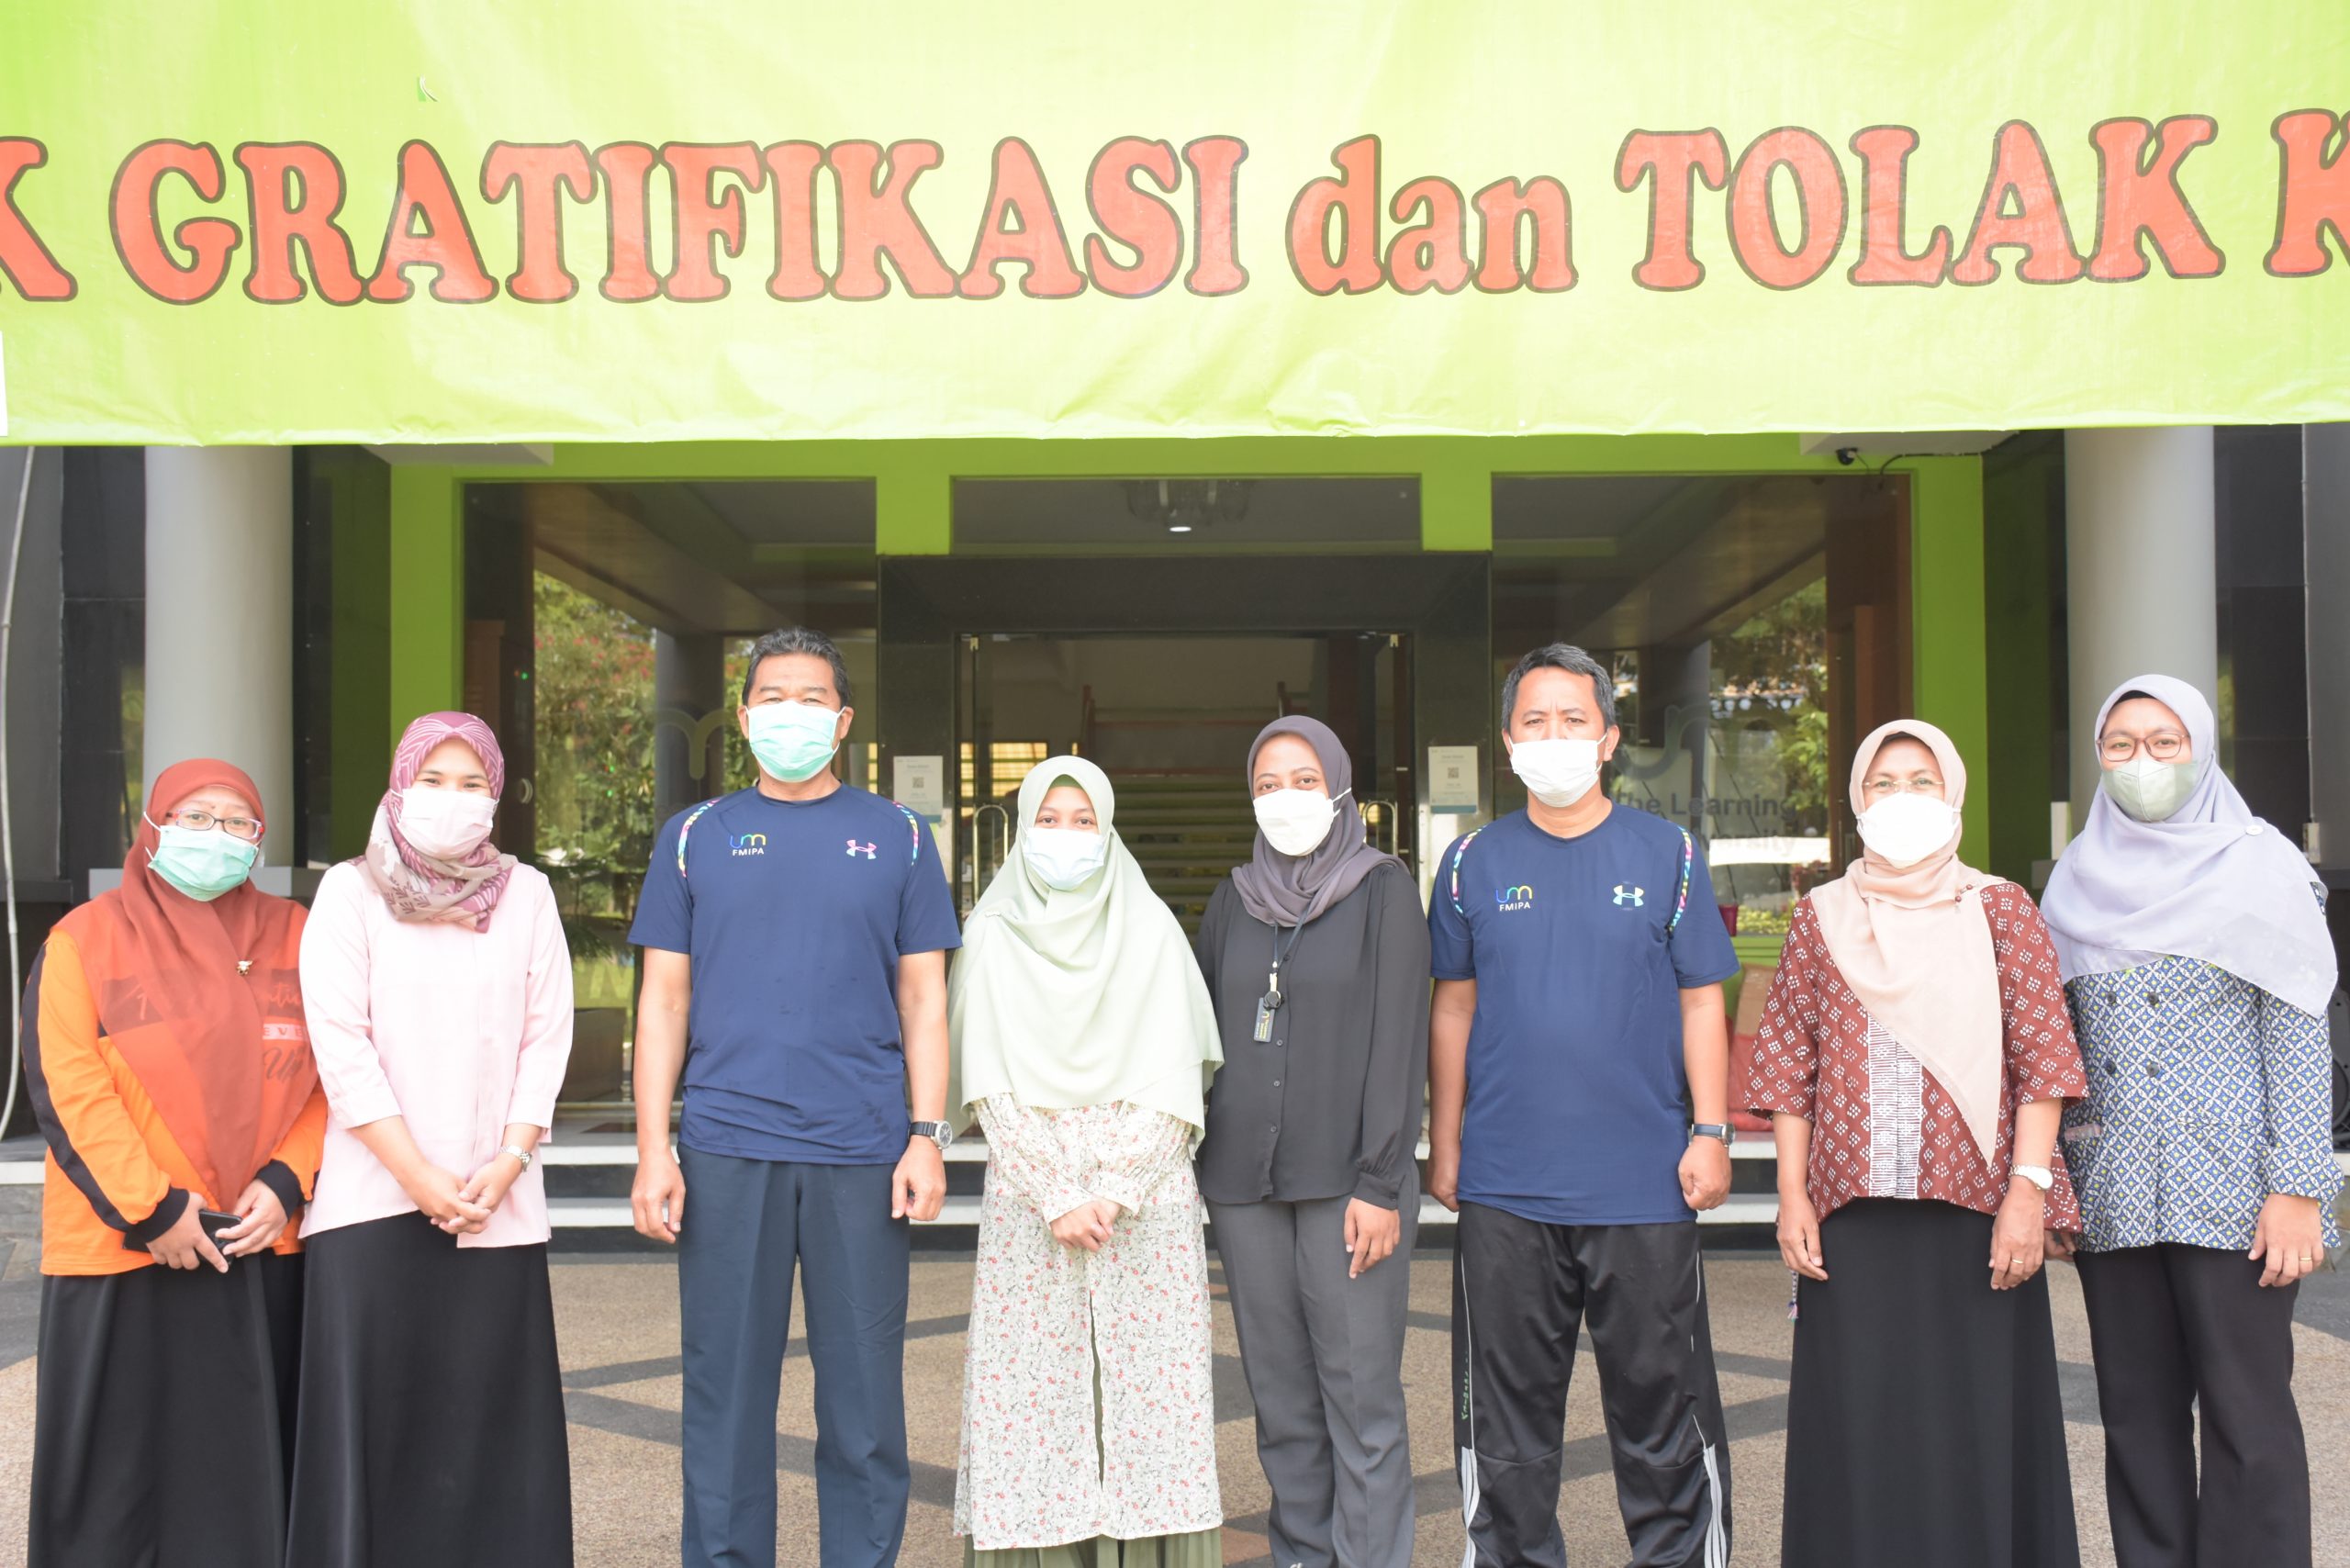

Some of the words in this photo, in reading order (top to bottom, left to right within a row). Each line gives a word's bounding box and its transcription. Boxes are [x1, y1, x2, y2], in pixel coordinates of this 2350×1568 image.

[108, 135, 1248, 306] GRATIFIKASI
[1286, 134, 1580, 297] dan
[1614, 116, 2226, 292] TOLAK
[1672, 792, 1796, 822] Learning
[732, 847, 765, 857] FMIPA
[1499, 902, 1531, 912] FMIPA
[263, 1026, 303, 1036] EVE
